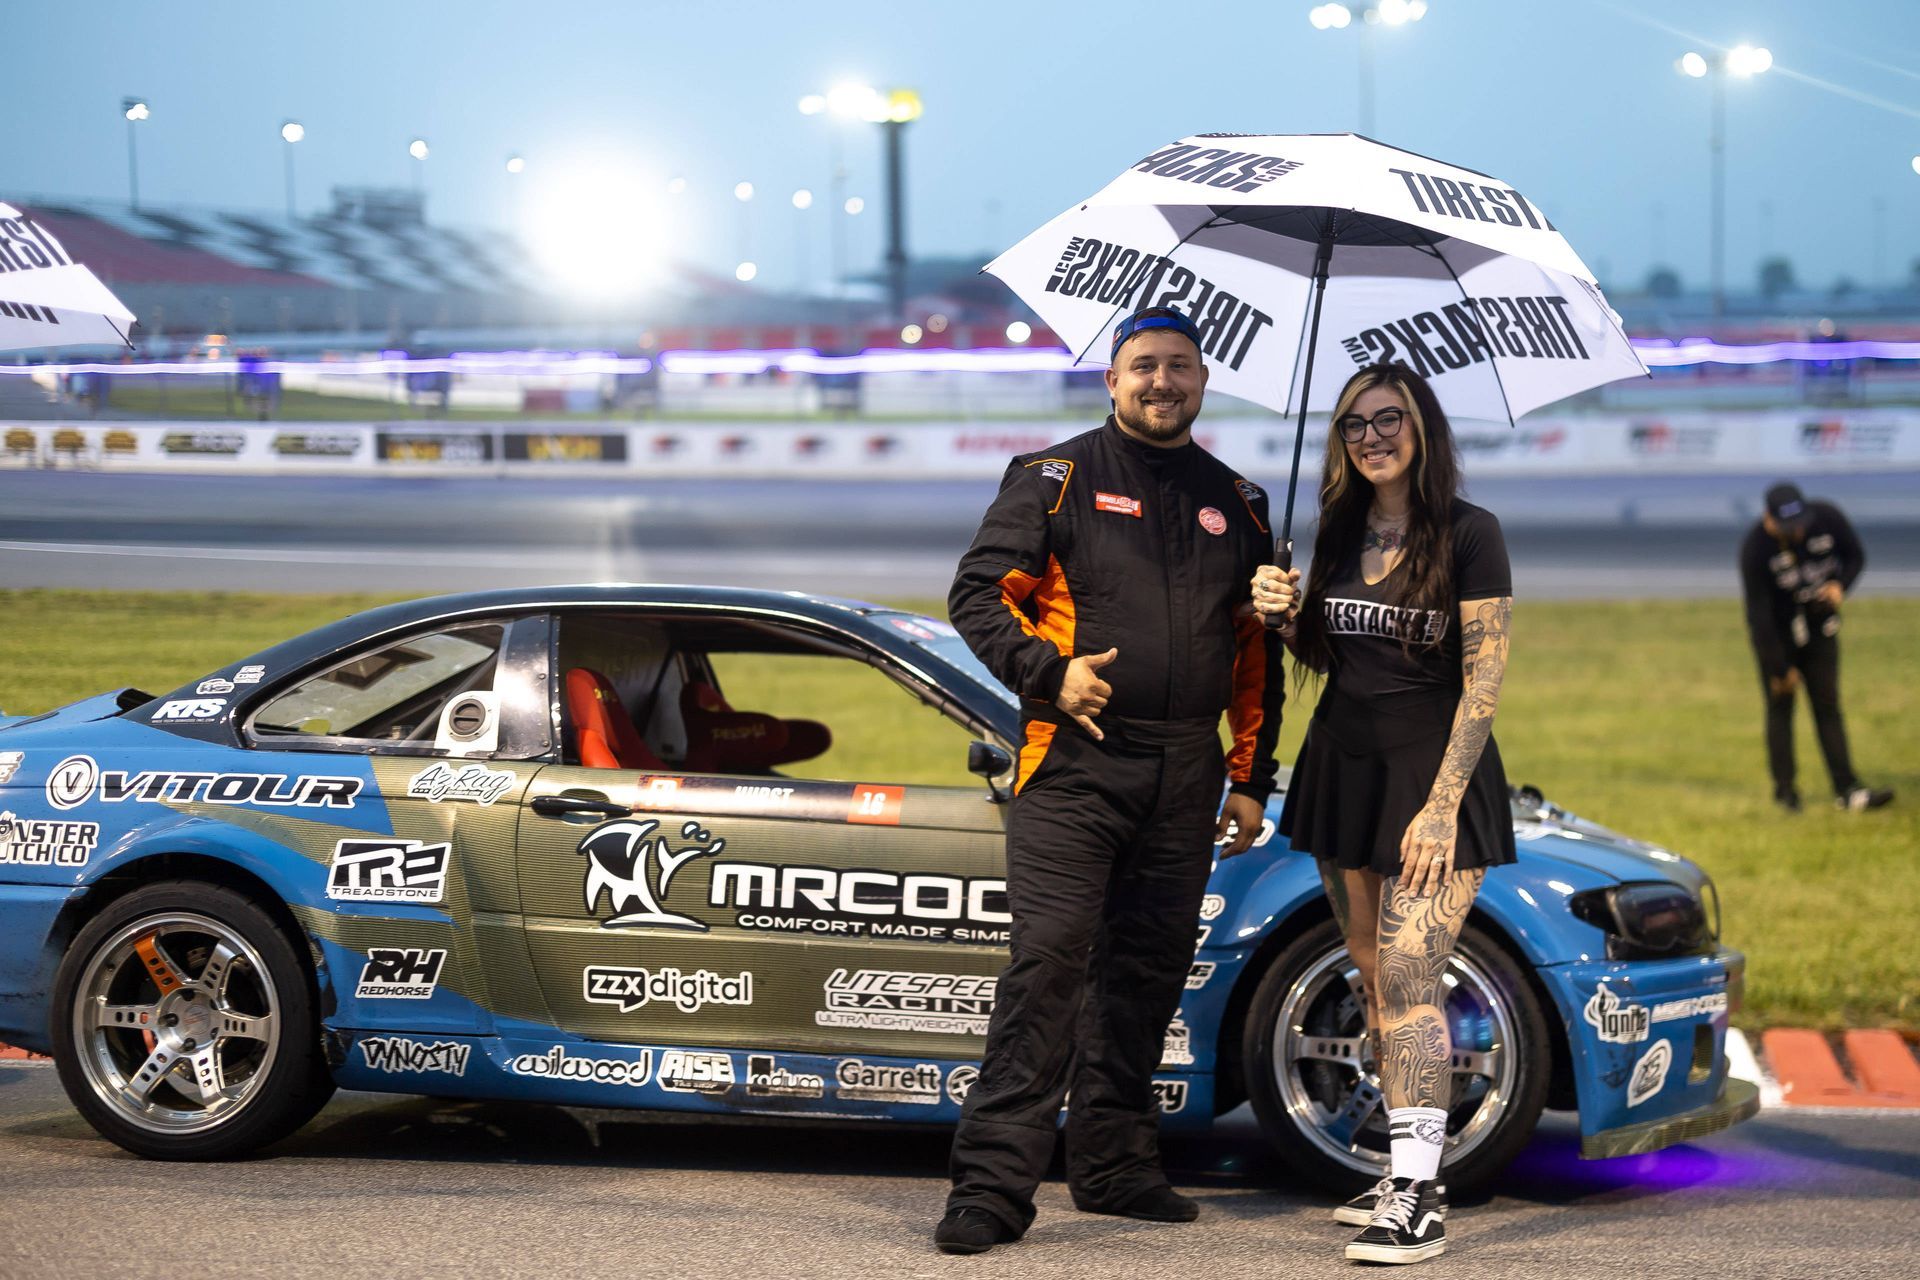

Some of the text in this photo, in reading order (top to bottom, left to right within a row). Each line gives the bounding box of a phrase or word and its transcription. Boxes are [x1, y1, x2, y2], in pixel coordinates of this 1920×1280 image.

[151, 699, 228, 719] RTS
[104, 774, 359, 806] VITOUR
[857, 791, 887, 816] 16
[58, 845, 87, 864] CO
[332, 887, 439, 898] TREADSTONE
[738, 914, 866, 934] COMFORT
[870, 923, 946, 938] MADE
[362, 950, 444, 983] RH
[358, 986, 432, 996] REDHORSE
[819, 1014, 867, 1025] ULTRA
[516, 1048, 650, 1084] wilwood
[661, 1053, 730, 1082] RISE
[840, 1062, 937, 1090] Garrett
